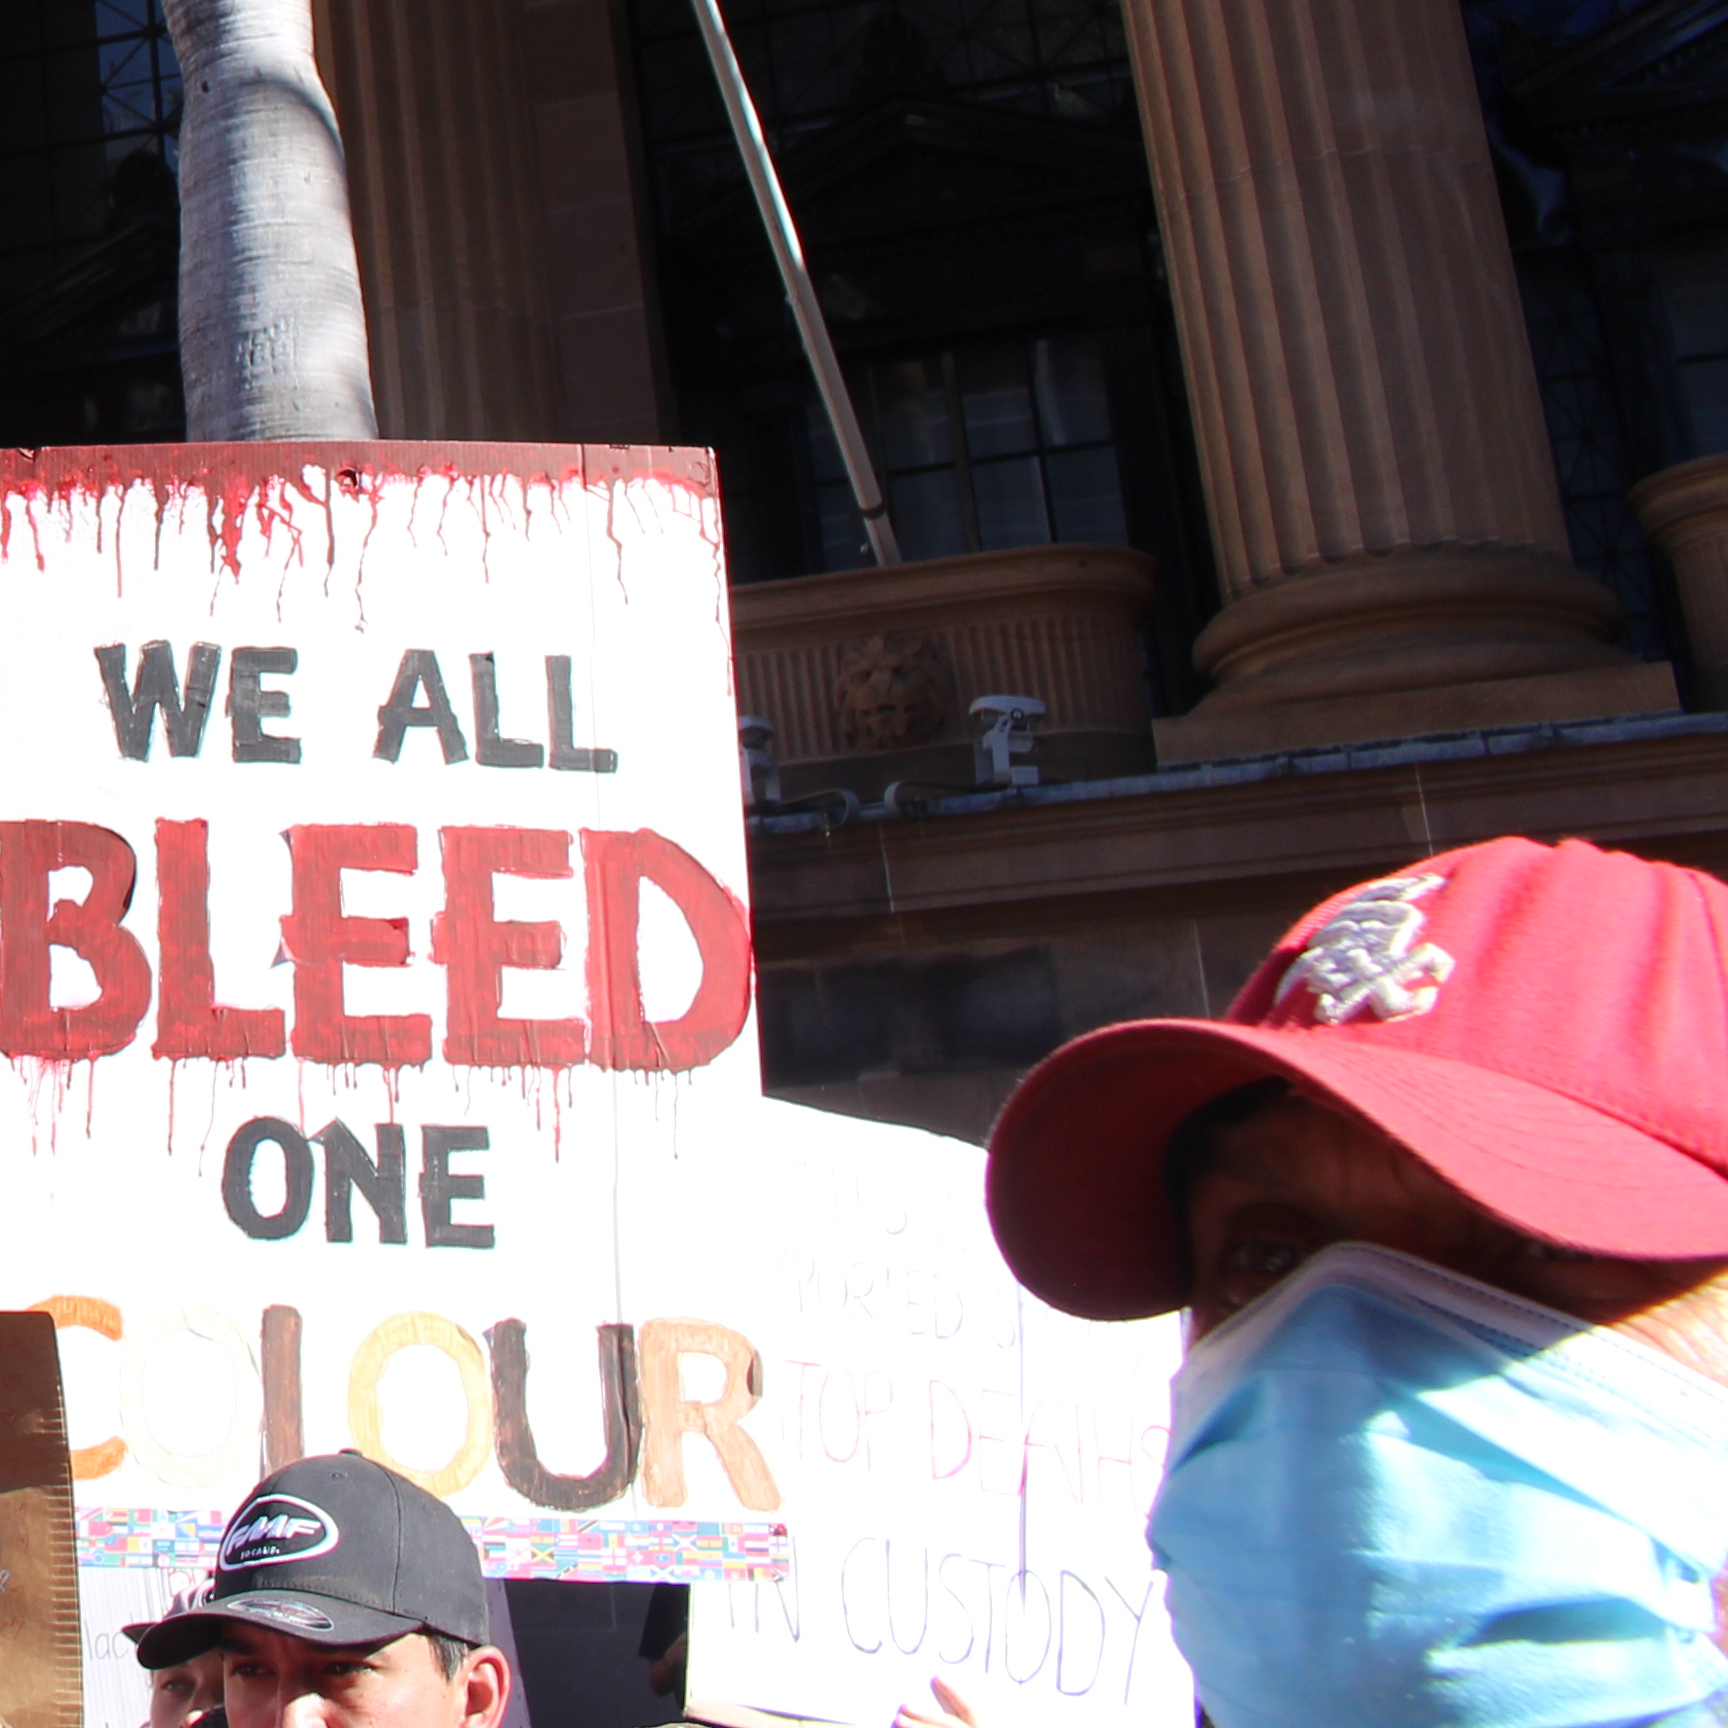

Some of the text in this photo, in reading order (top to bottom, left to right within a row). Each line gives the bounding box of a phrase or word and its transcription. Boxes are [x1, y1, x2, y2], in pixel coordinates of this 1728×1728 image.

[95, 639, 619, 772] WE ALL
[220, 1116, 497, 1249] ONE
[781, 1358, 897, 1474] TOP
[225, 1513, 322, 1557] FMF
[841, 1536, 1156, 1707] CUSTODY
